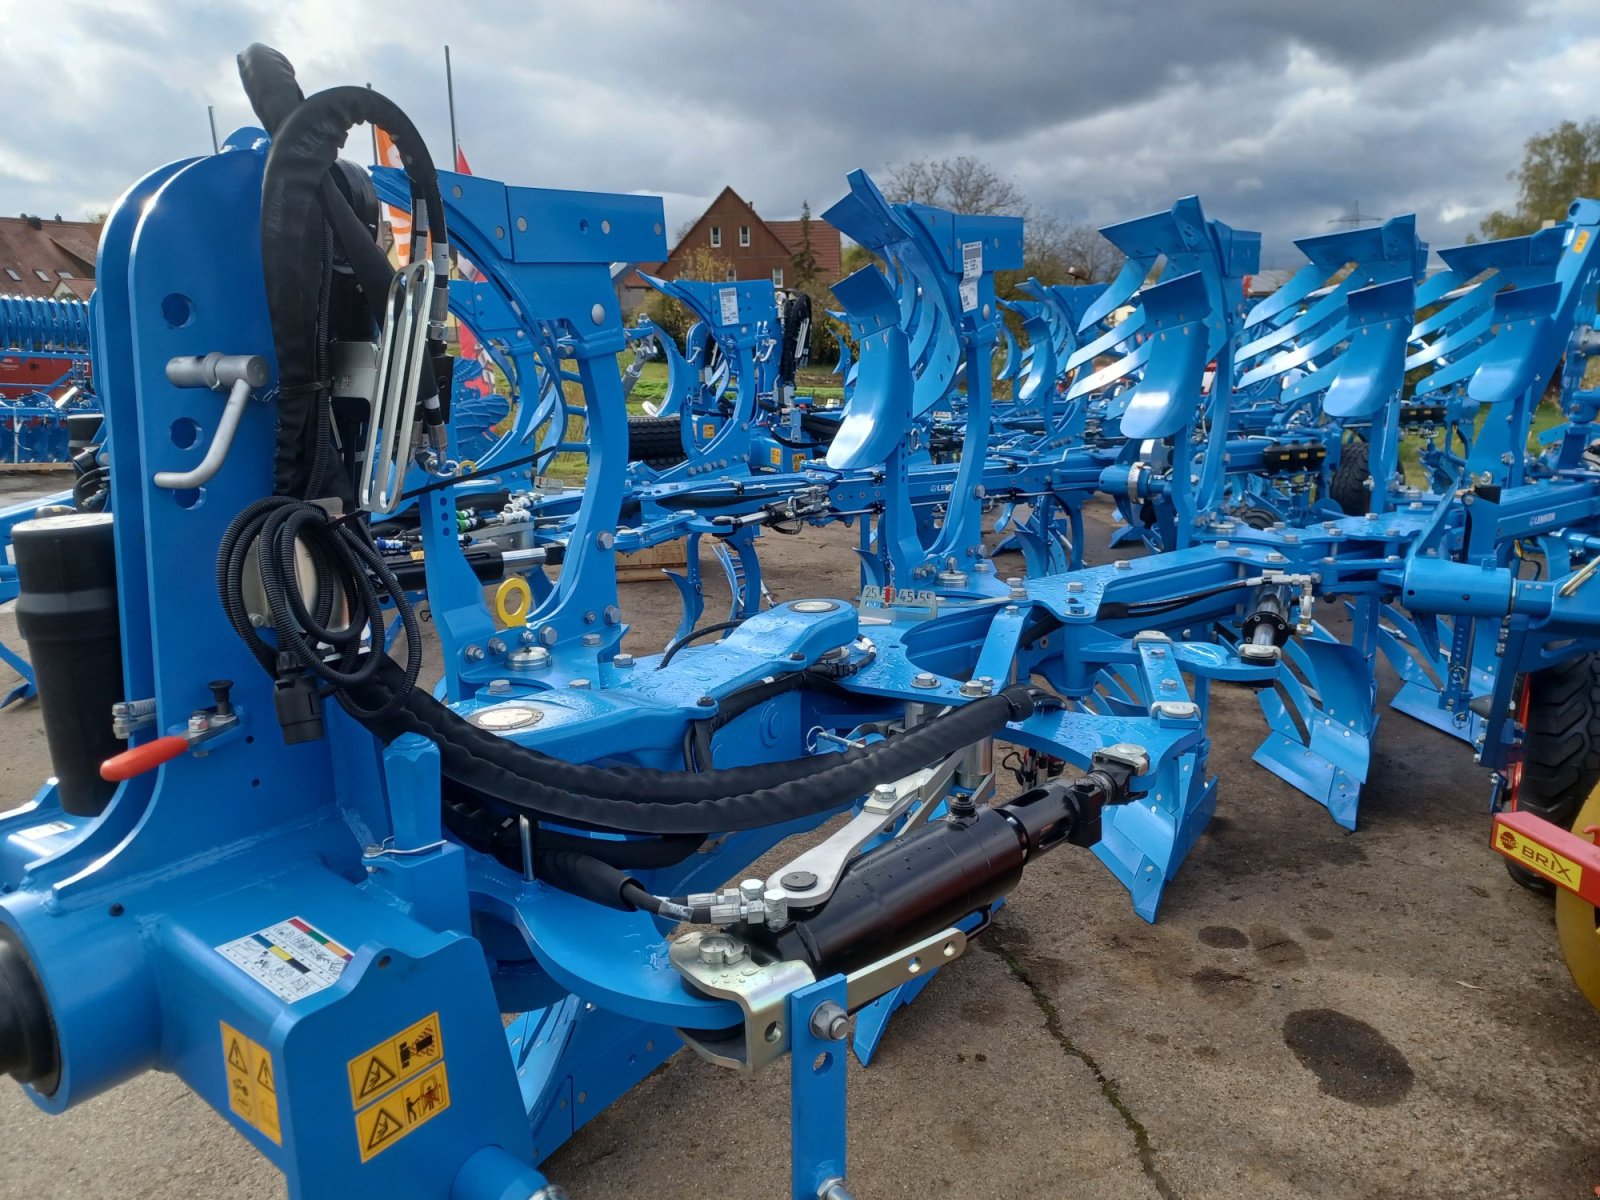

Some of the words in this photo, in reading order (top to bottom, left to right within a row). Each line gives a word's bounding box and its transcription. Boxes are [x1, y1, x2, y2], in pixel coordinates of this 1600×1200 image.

[865, 587, 877, 599] 25
[899, 590, 914, 603] 45
[1521, 845, 1573, 883] BRIX
